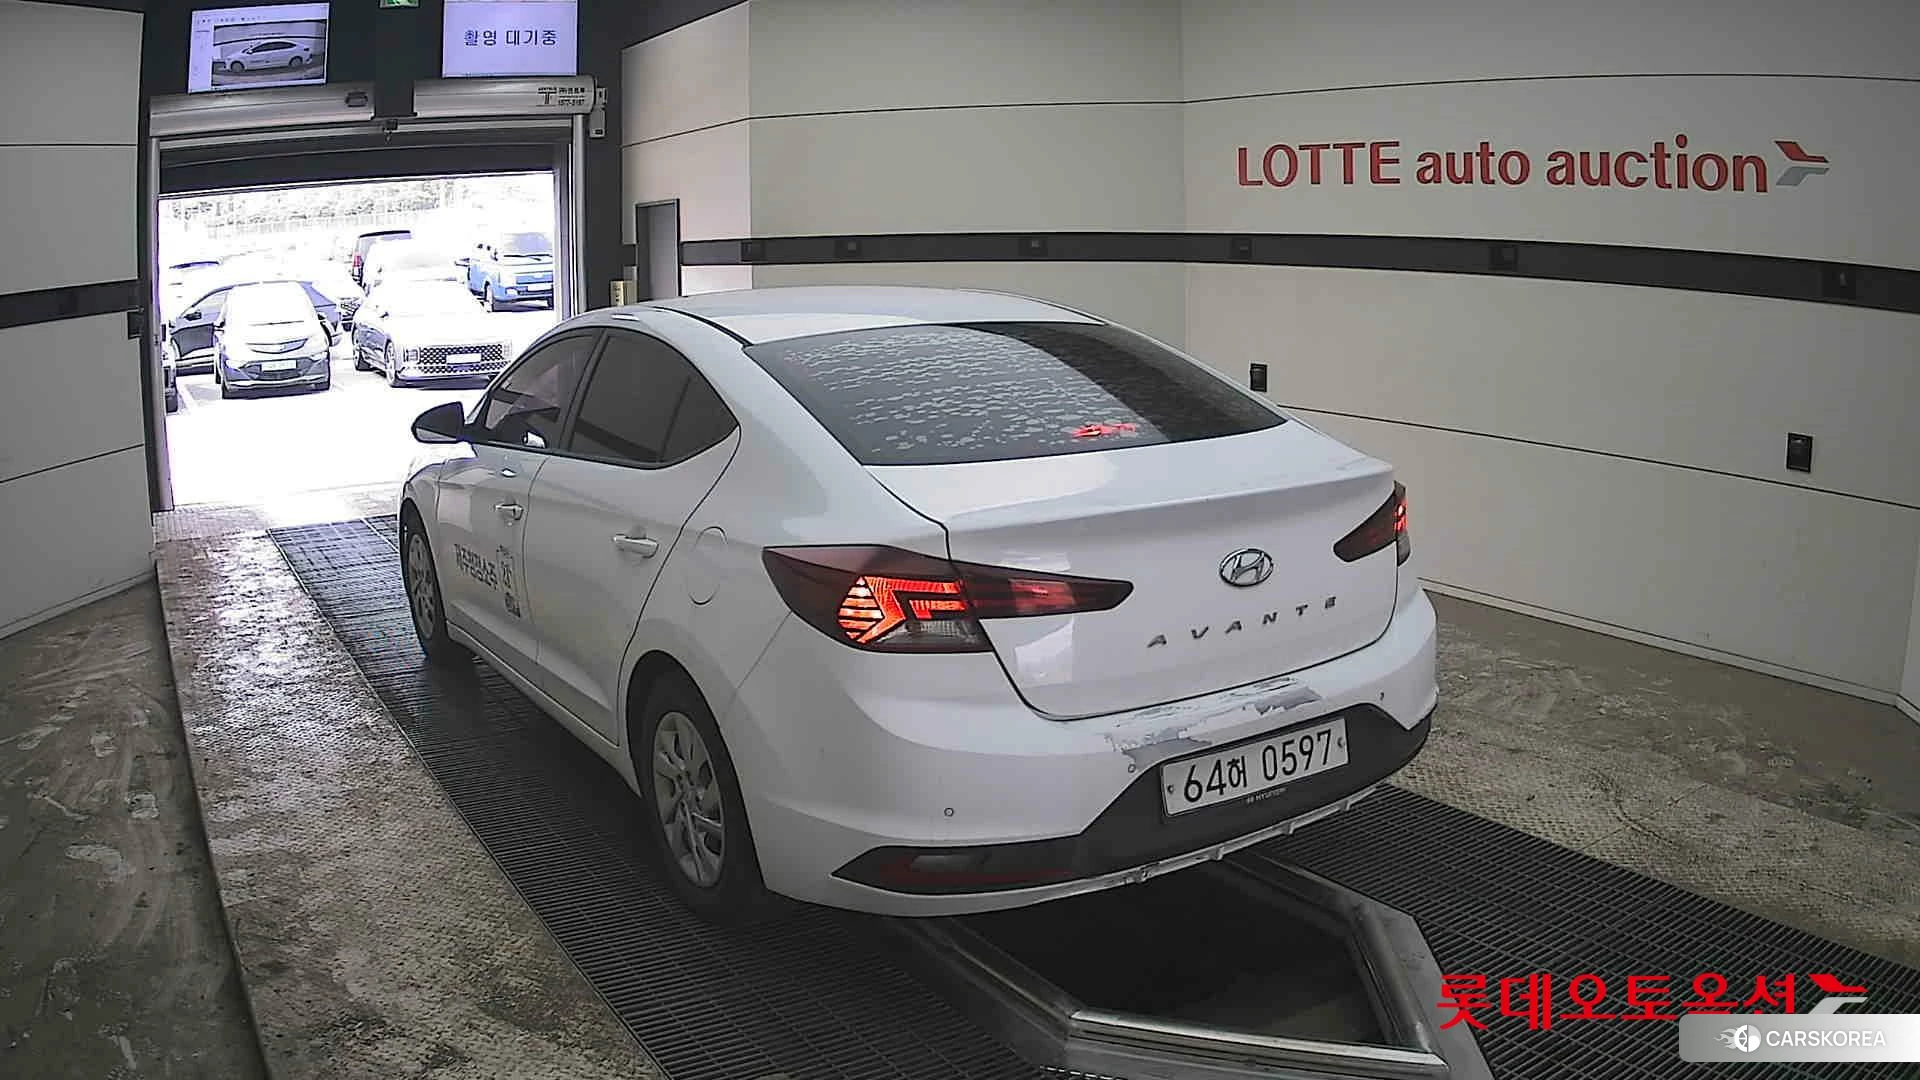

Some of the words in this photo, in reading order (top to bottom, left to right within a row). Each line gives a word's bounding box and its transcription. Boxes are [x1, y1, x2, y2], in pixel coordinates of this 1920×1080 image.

[464, 29, 497, 46] 촬영
[505, 29, 557, 46] 대기중
[1238, 141, 1400, 187] LOTTE
[1416, 141, 1531, 185] auto
[1546, 134, 1769, 193] auction
[1147, 597, 1336, 648] AVANTE
[1183, 755, 1247, 802] 64허
[1262, 728, 1332, 781] 0597
